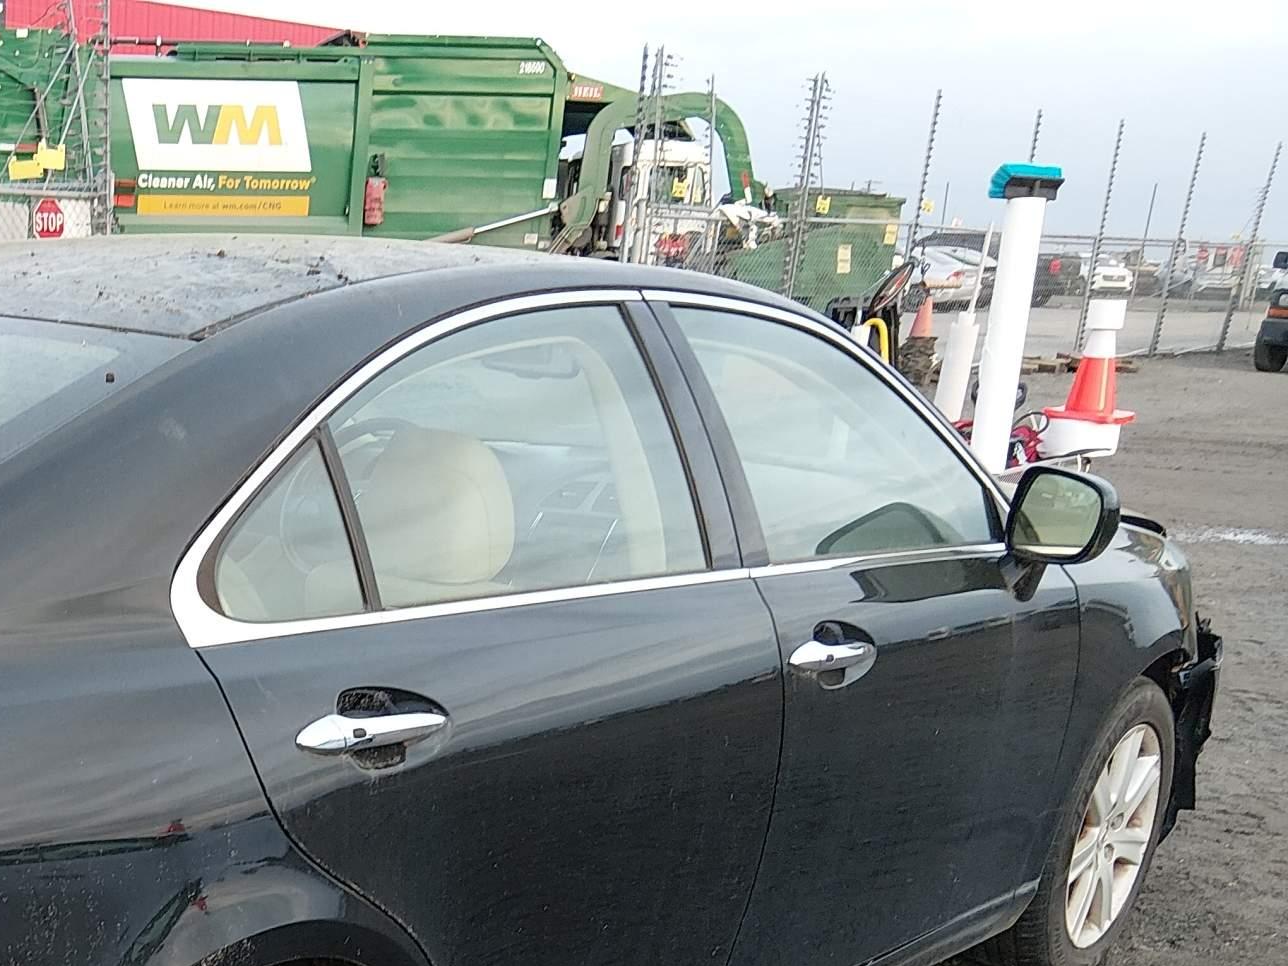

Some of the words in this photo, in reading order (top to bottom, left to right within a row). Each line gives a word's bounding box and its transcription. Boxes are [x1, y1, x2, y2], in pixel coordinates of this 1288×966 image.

[152, 104, 284, 145] WM
[138, 173, 191, 189] Cleaner
[192, 174, 216, 191] Air,
[218, 175, 241, 190] For
[35, 212, 63, 233] STOP
